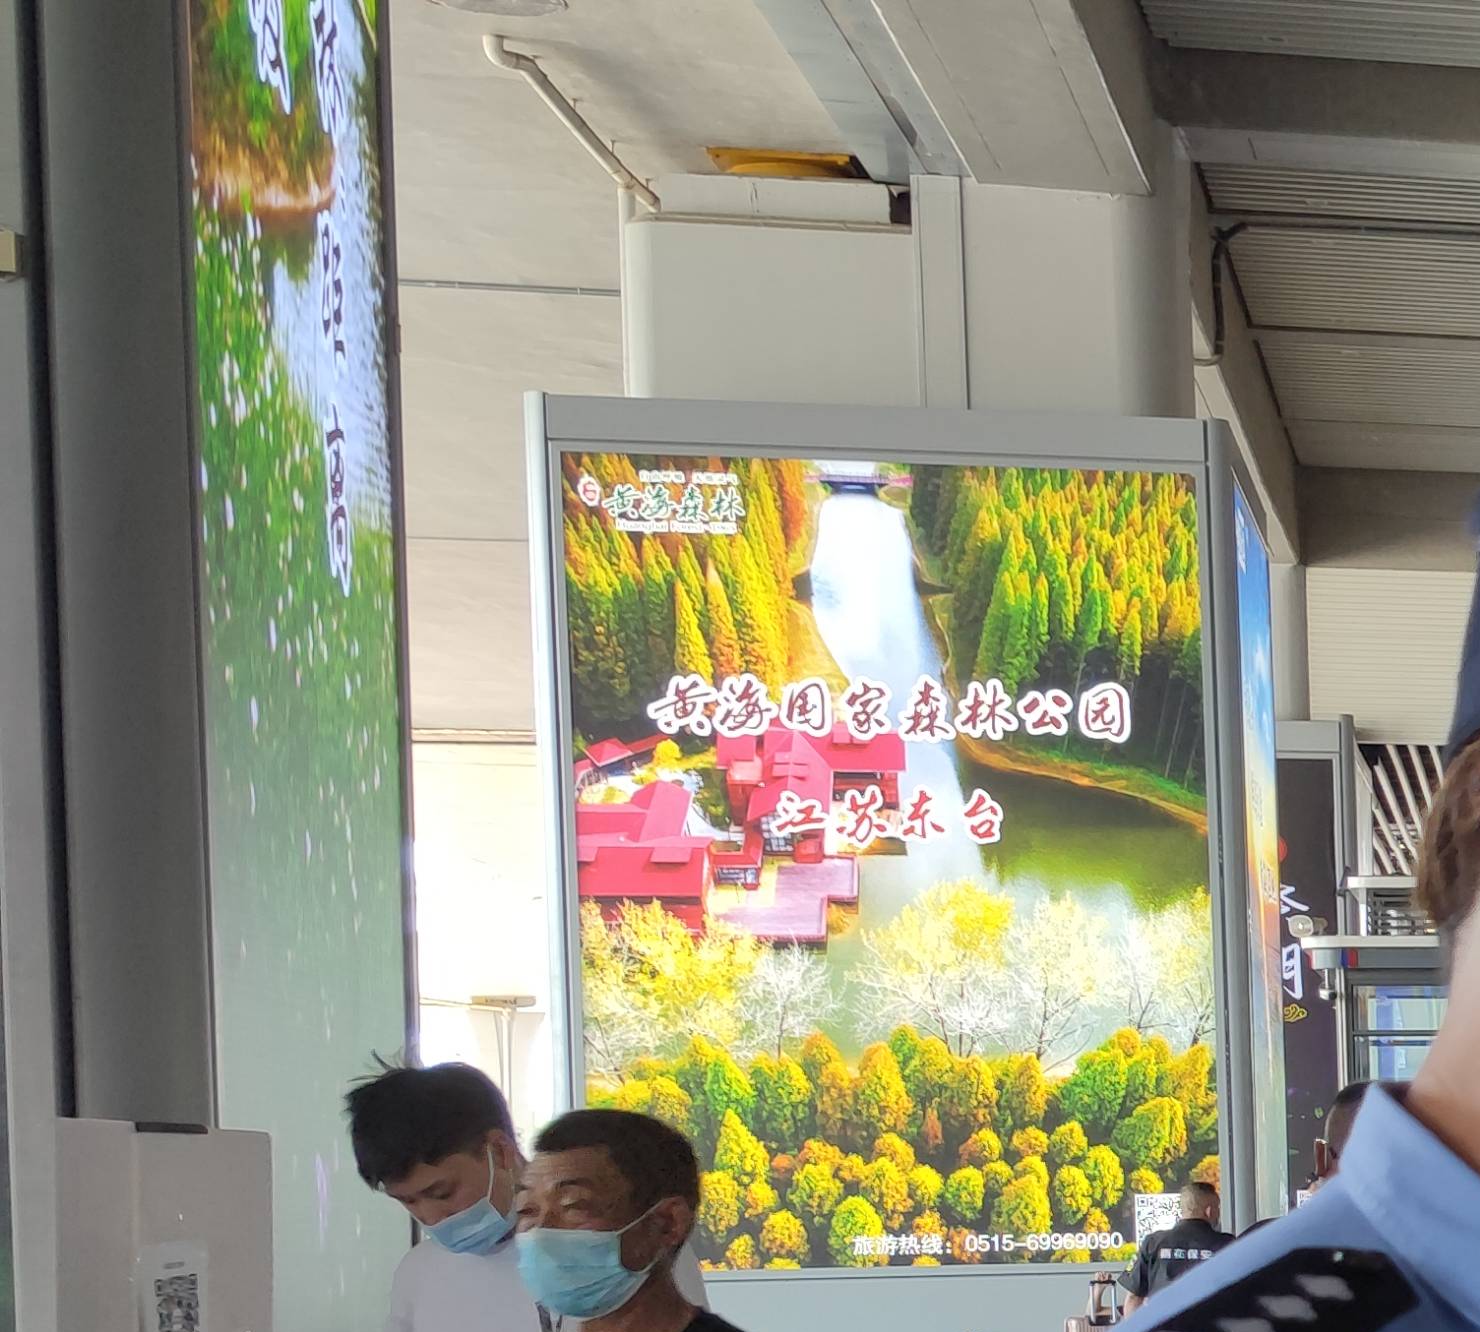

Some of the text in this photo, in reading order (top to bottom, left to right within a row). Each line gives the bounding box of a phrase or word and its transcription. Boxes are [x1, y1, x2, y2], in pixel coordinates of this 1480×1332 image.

[603, 484, 745, 521] 黄海森林
[647, 674, 1132, 744] 黄海国家森林公园
[774, 786, 1006, 846] 江苏东台
